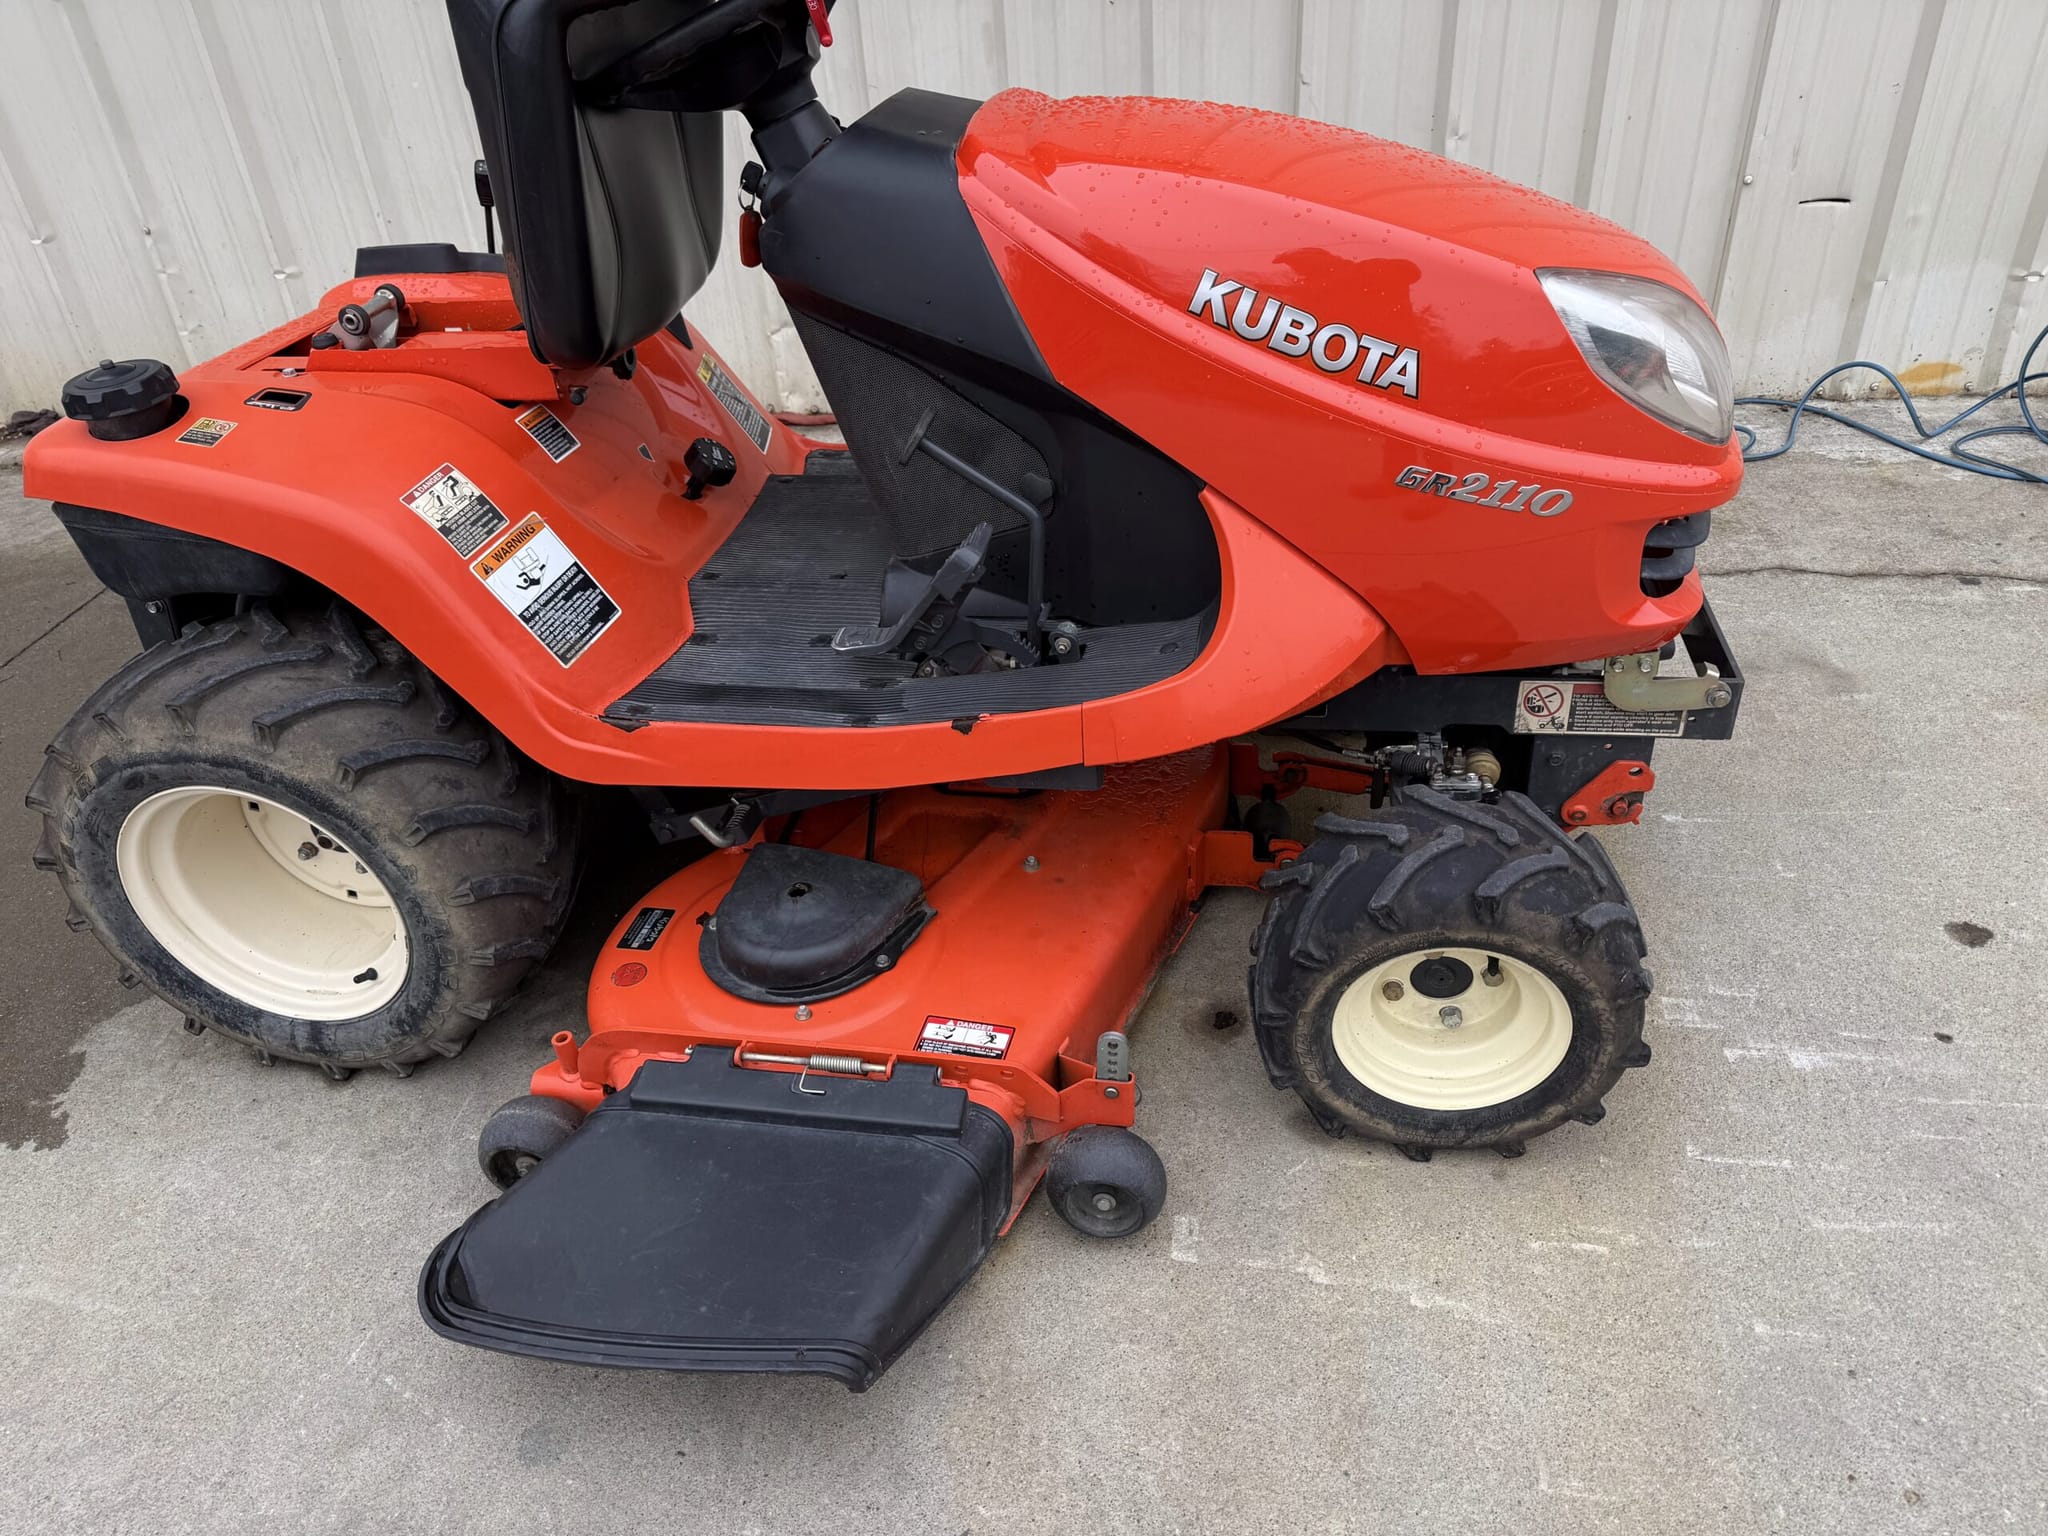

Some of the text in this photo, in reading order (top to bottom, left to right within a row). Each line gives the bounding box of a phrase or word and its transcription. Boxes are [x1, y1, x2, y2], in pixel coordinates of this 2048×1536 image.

[1187, 267, 1420, 399] KUBOTA
[418, 471, 444, 492] DANGER
[1394, 465, 1574, 517] GR2110
[491, 524, 536, 563] WARNING
[522, 610, 531, 618] TO
[528, 601, 540, 613] AVOID
[537, 589, 553, 604] SERIOUS
[550, 579, 564, 592] INJURY
[561, 574, 569, 582] OR
[957, 1022, 994, 1031] DANGER
